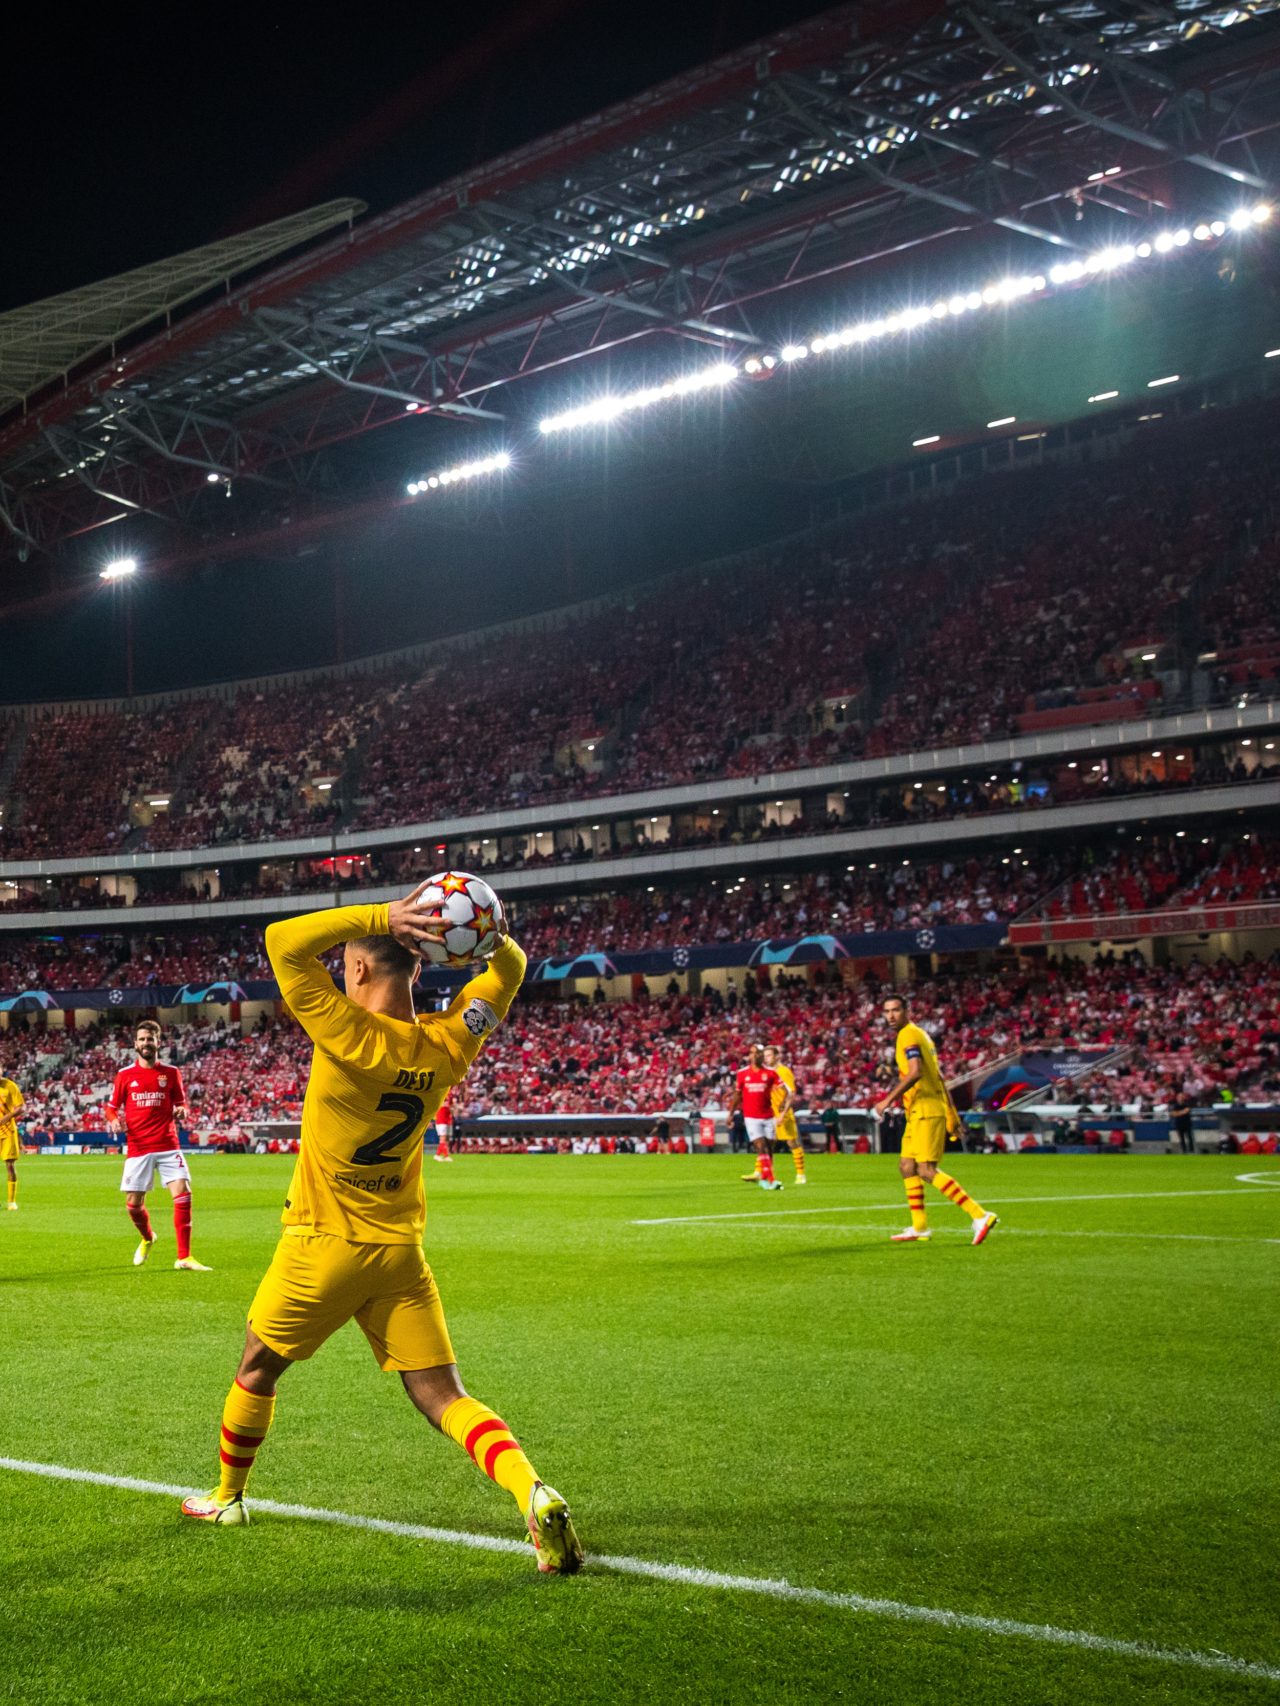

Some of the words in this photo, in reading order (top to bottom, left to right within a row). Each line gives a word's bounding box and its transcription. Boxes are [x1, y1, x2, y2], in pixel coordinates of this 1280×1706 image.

[393, 1069, 436, 1091] DEST
[131, 1091, 166, 1101] Emirates
[350, 1092, 424, 1165] 2
